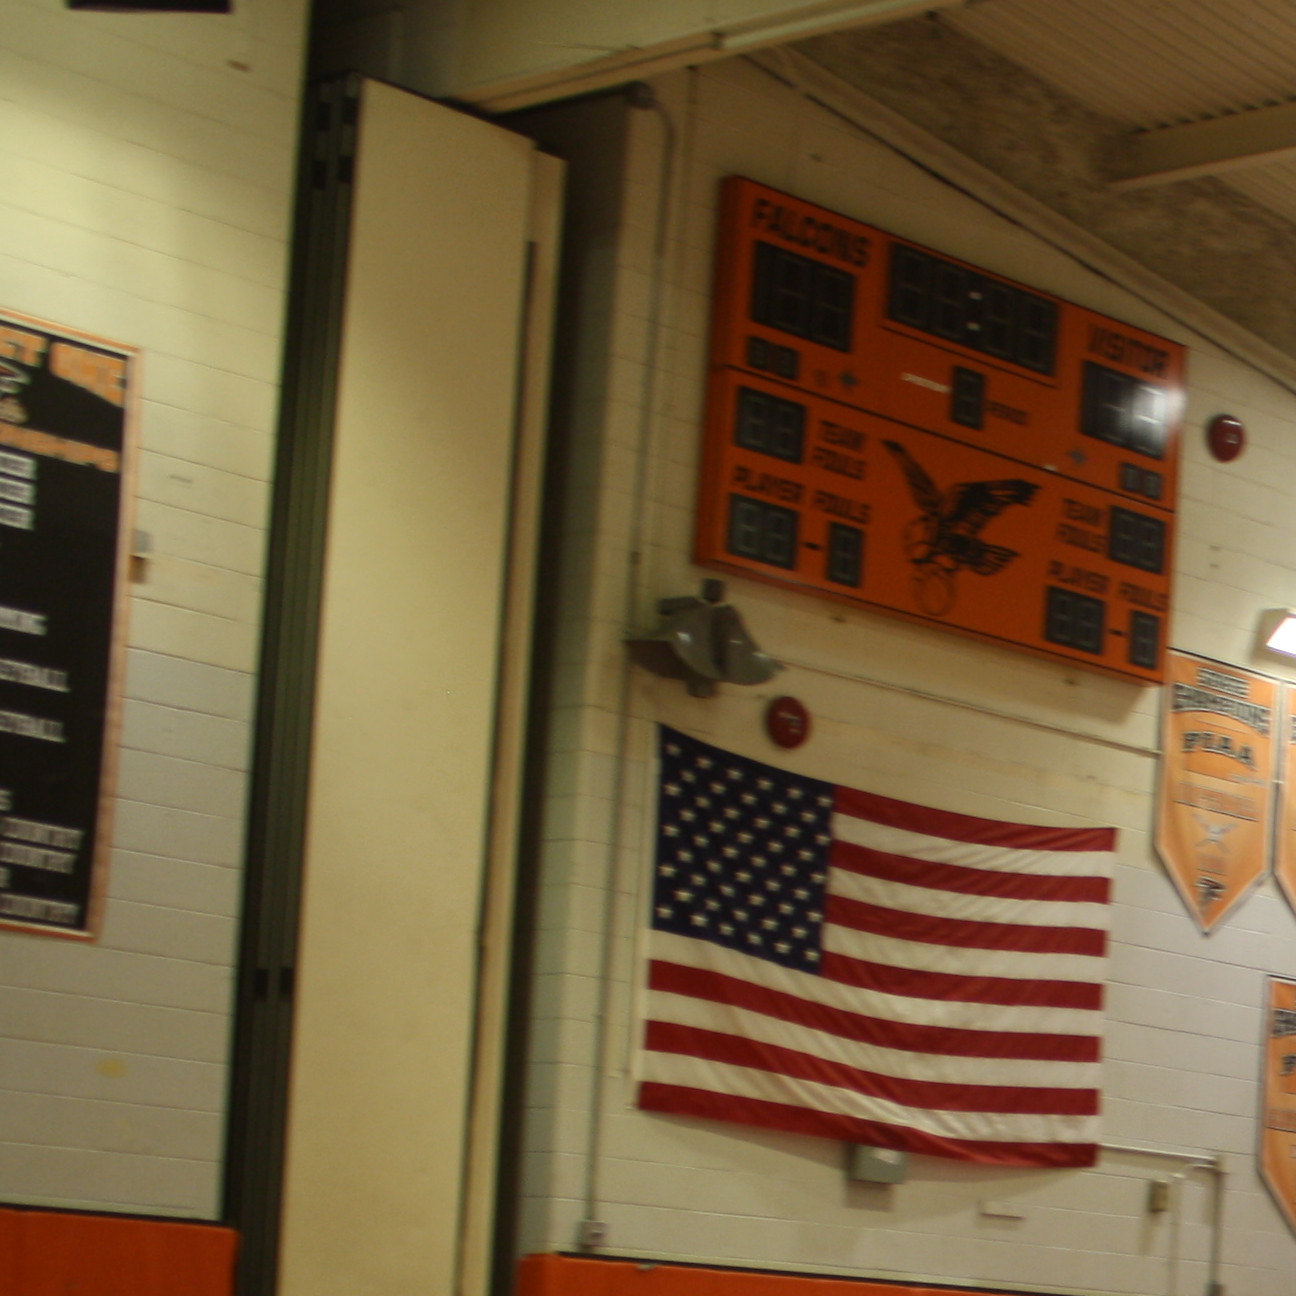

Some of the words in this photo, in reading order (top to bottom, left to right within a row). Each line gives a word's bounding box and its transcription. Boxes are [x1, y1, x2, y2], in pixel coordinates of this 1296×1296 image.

[752, 198, 871, 268] FALCONS
[1087, 323, 1171, 379] VISITOR
[811, 445, 867, 481] FOULS
[818, 419, 868, 452] TEAM
[731, 464, 805, 505] PLAYER
[811, 489, 872, 525] FOULS
